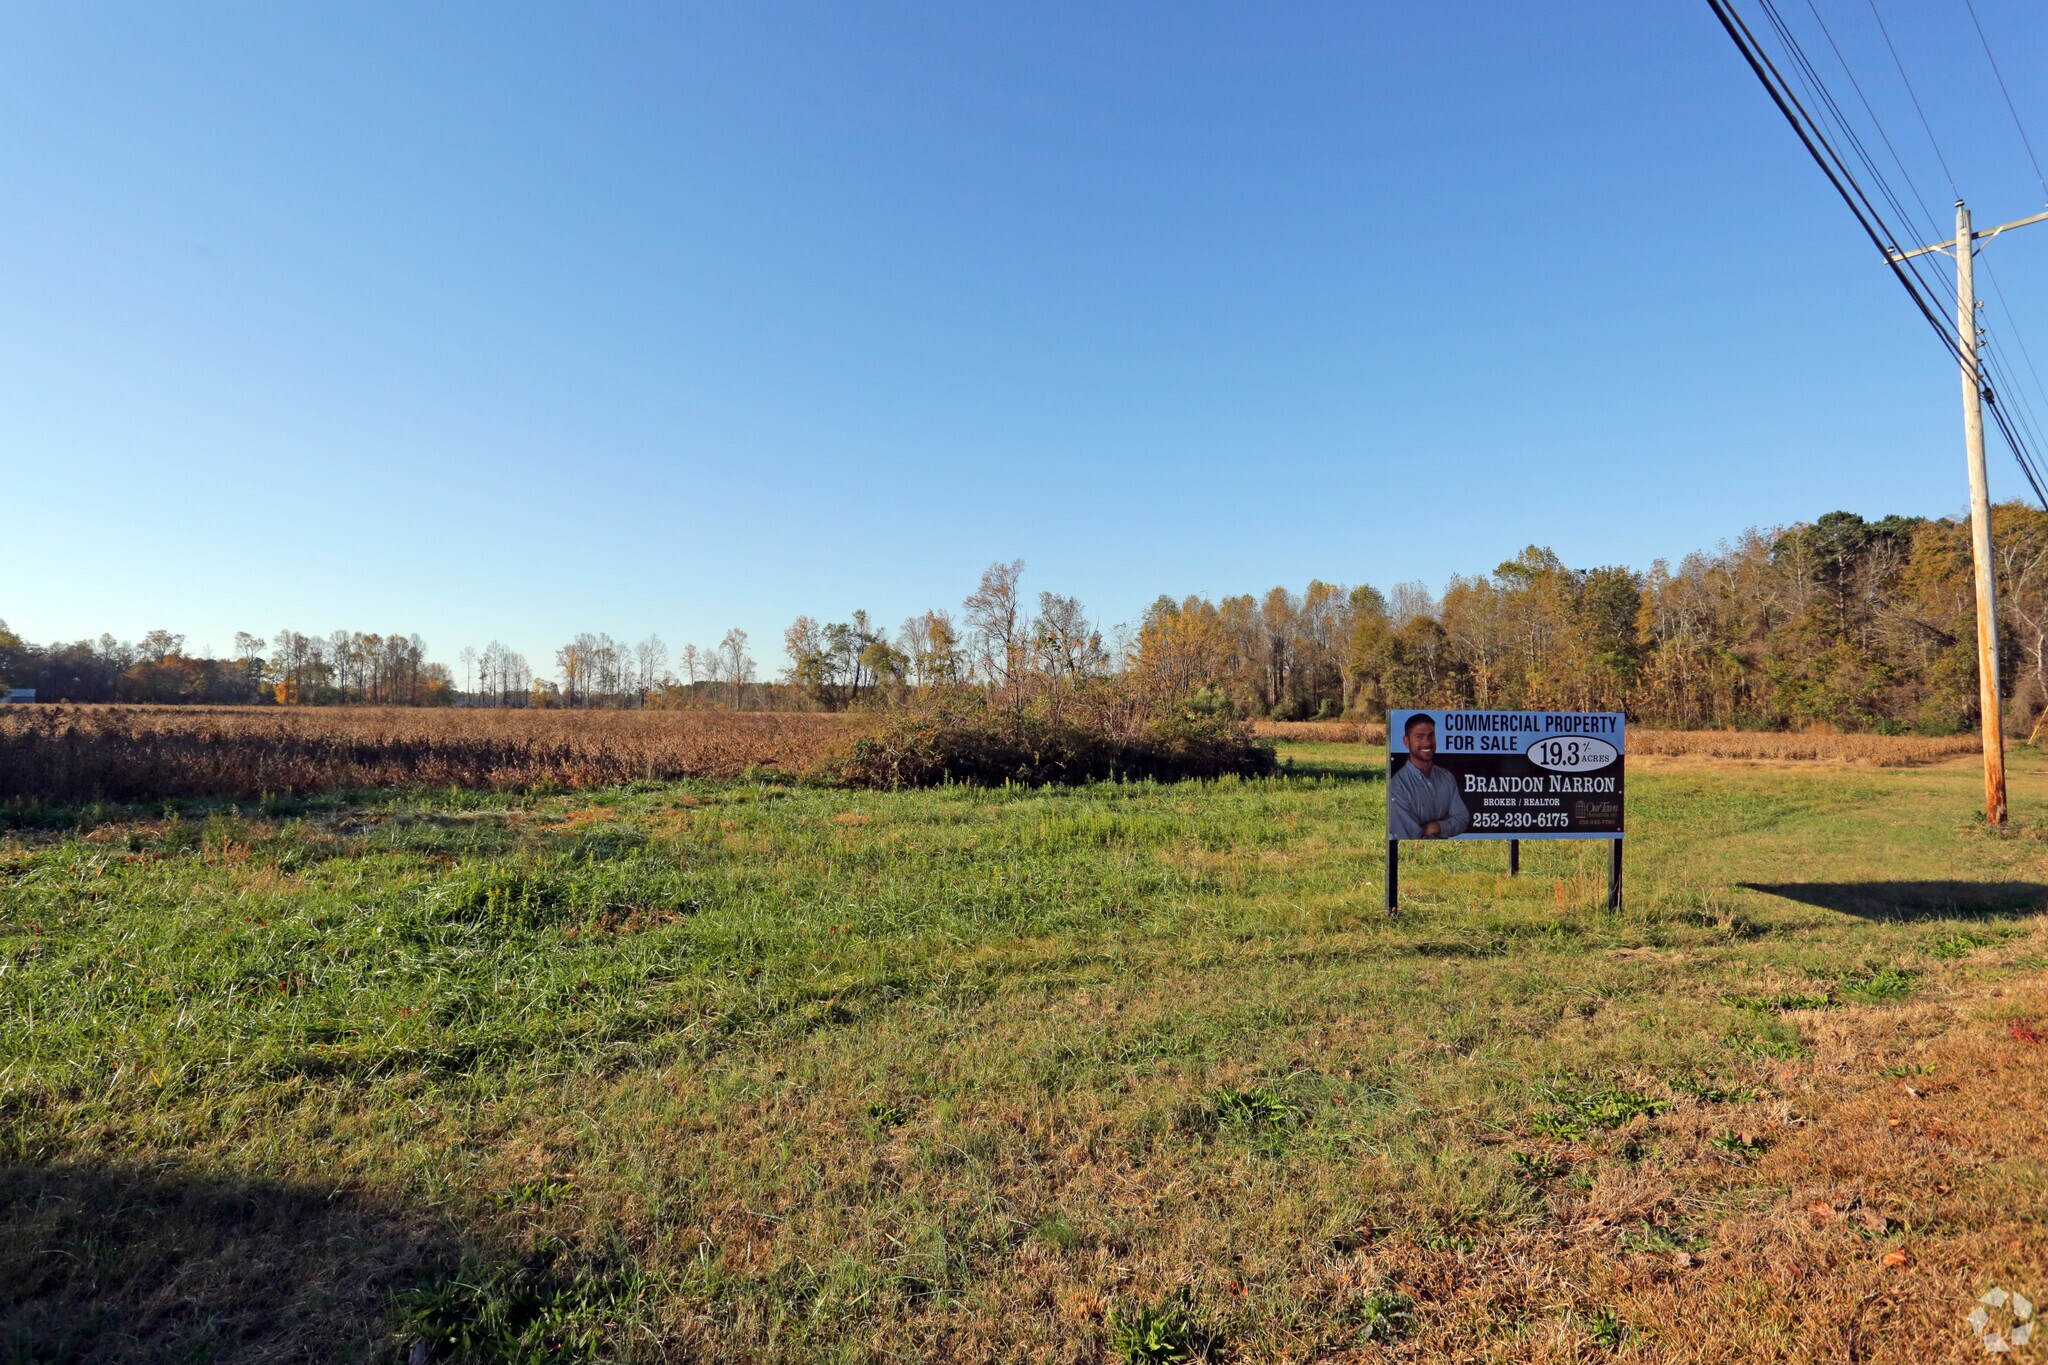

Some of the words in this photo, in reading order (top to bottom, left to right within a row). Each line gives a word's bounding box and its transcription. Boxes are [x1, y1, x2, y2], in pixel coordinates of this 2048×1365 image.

[1445, 713, 1540, 733] COMMERCIAL
[1545, 715, 1617, 733] PROPERTY
[1445, 735, 1475, 751] FOR
[1480, 735, 1518, 751] SALE
[1540, 741, 1580, 766] 19.3
[1581, 754, 1610, 763] ACRES
[1464, 773, 1544, 793] BRANDON
[1548, 774, 1615, 793] NARRON
[1483, 798, 1517, 806] BROKER
[1523, 798, 1560, 806] REALTOR
[1472, 812, 1569, 828] 252-230-6175
